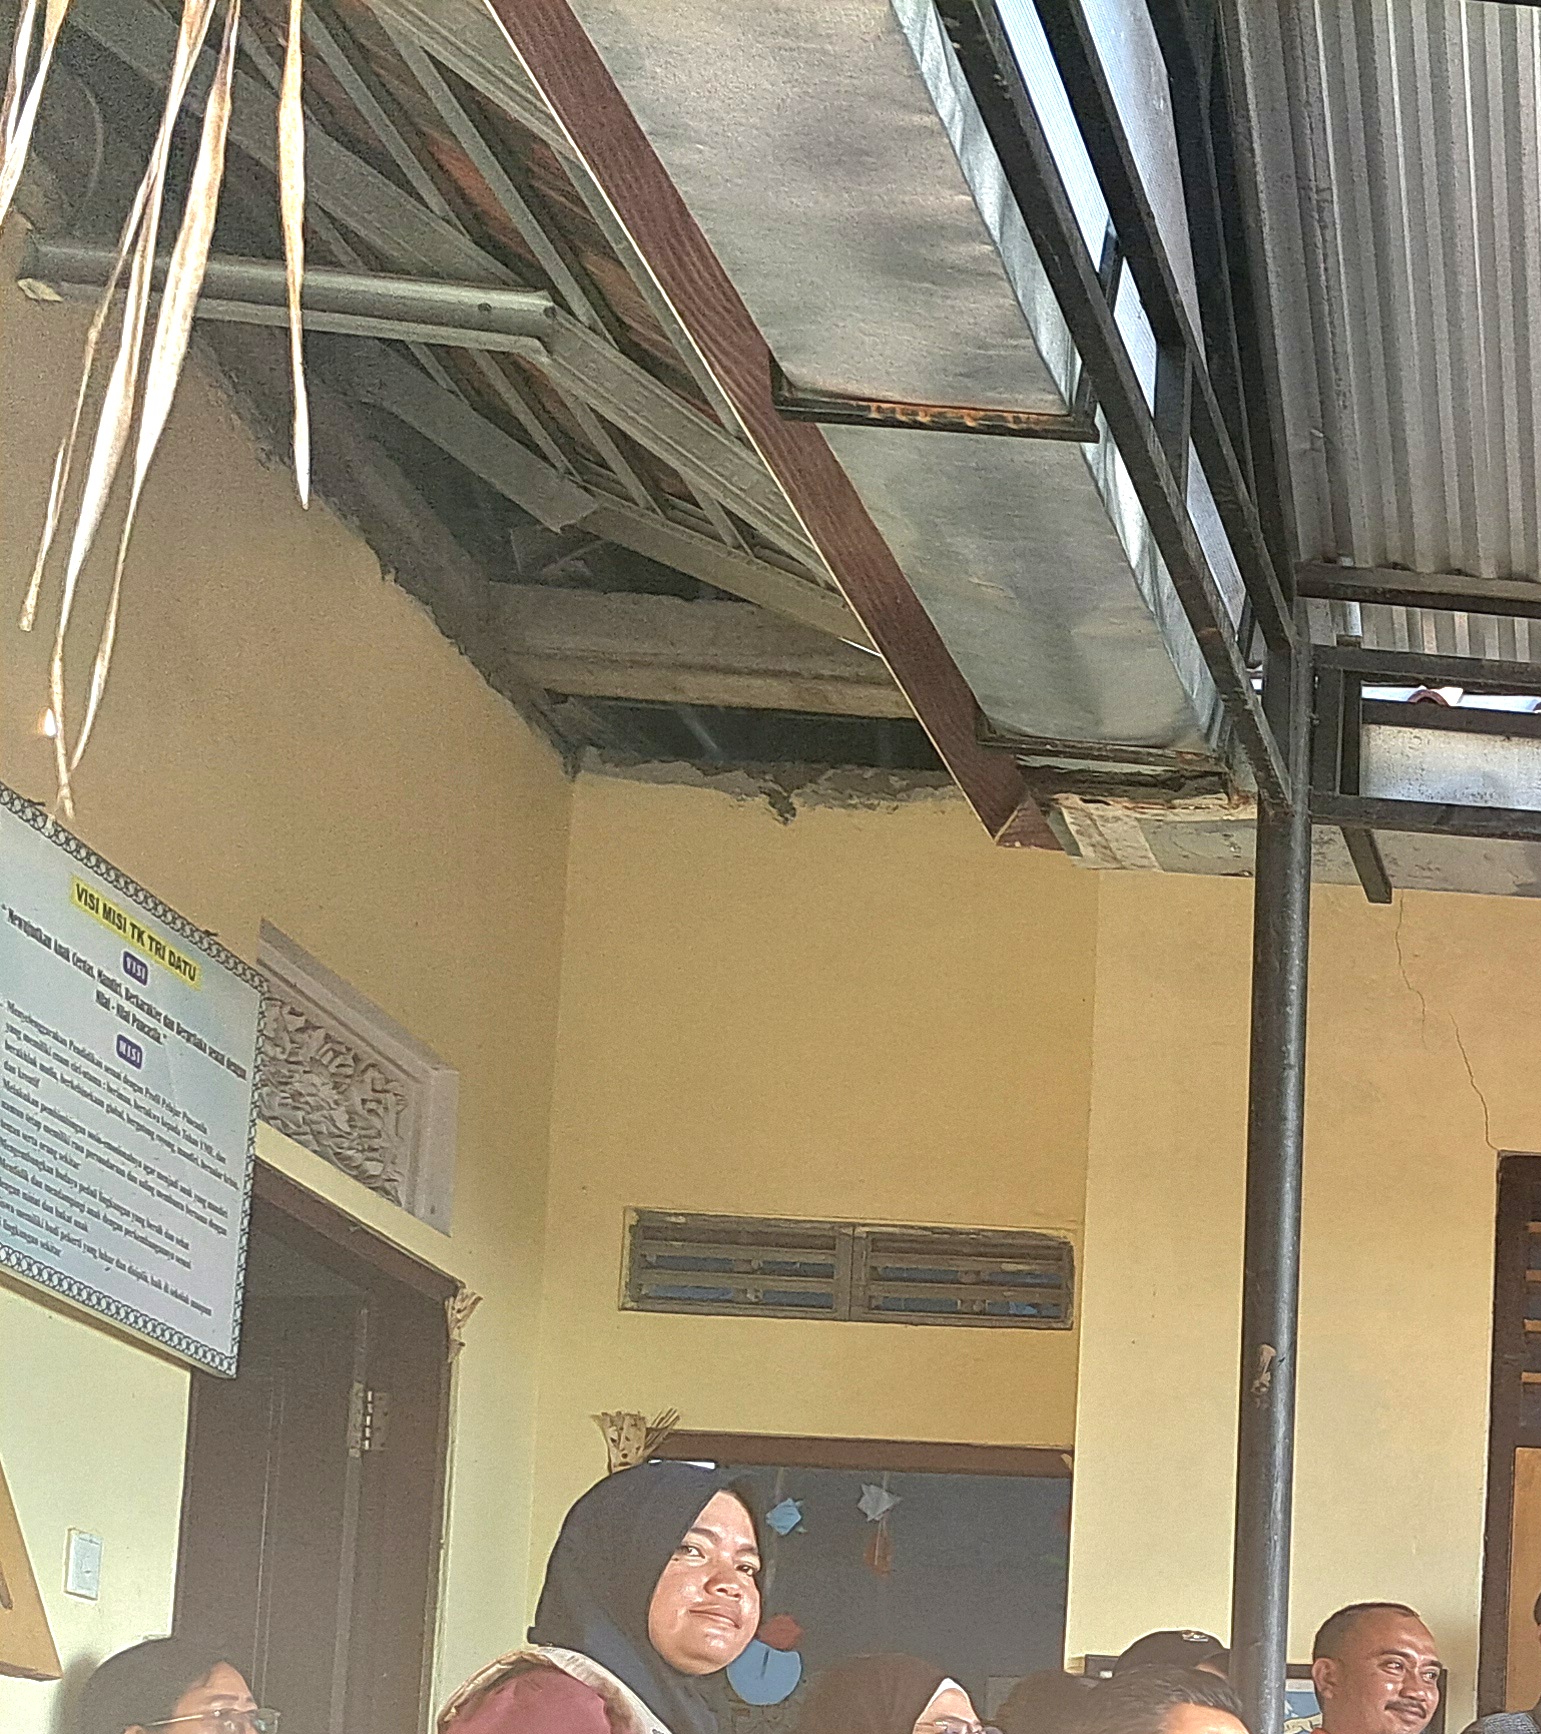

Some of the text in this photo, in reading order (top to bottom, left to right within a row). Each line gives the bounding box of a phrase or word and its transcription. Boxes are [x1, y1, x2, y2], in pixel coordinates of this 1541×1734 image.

[76, 883, 196, 982] VISI MISI TK TRI DATU
[125, 955, 147, 981] VISI
[119, 1039, 141, 1064] MISI
